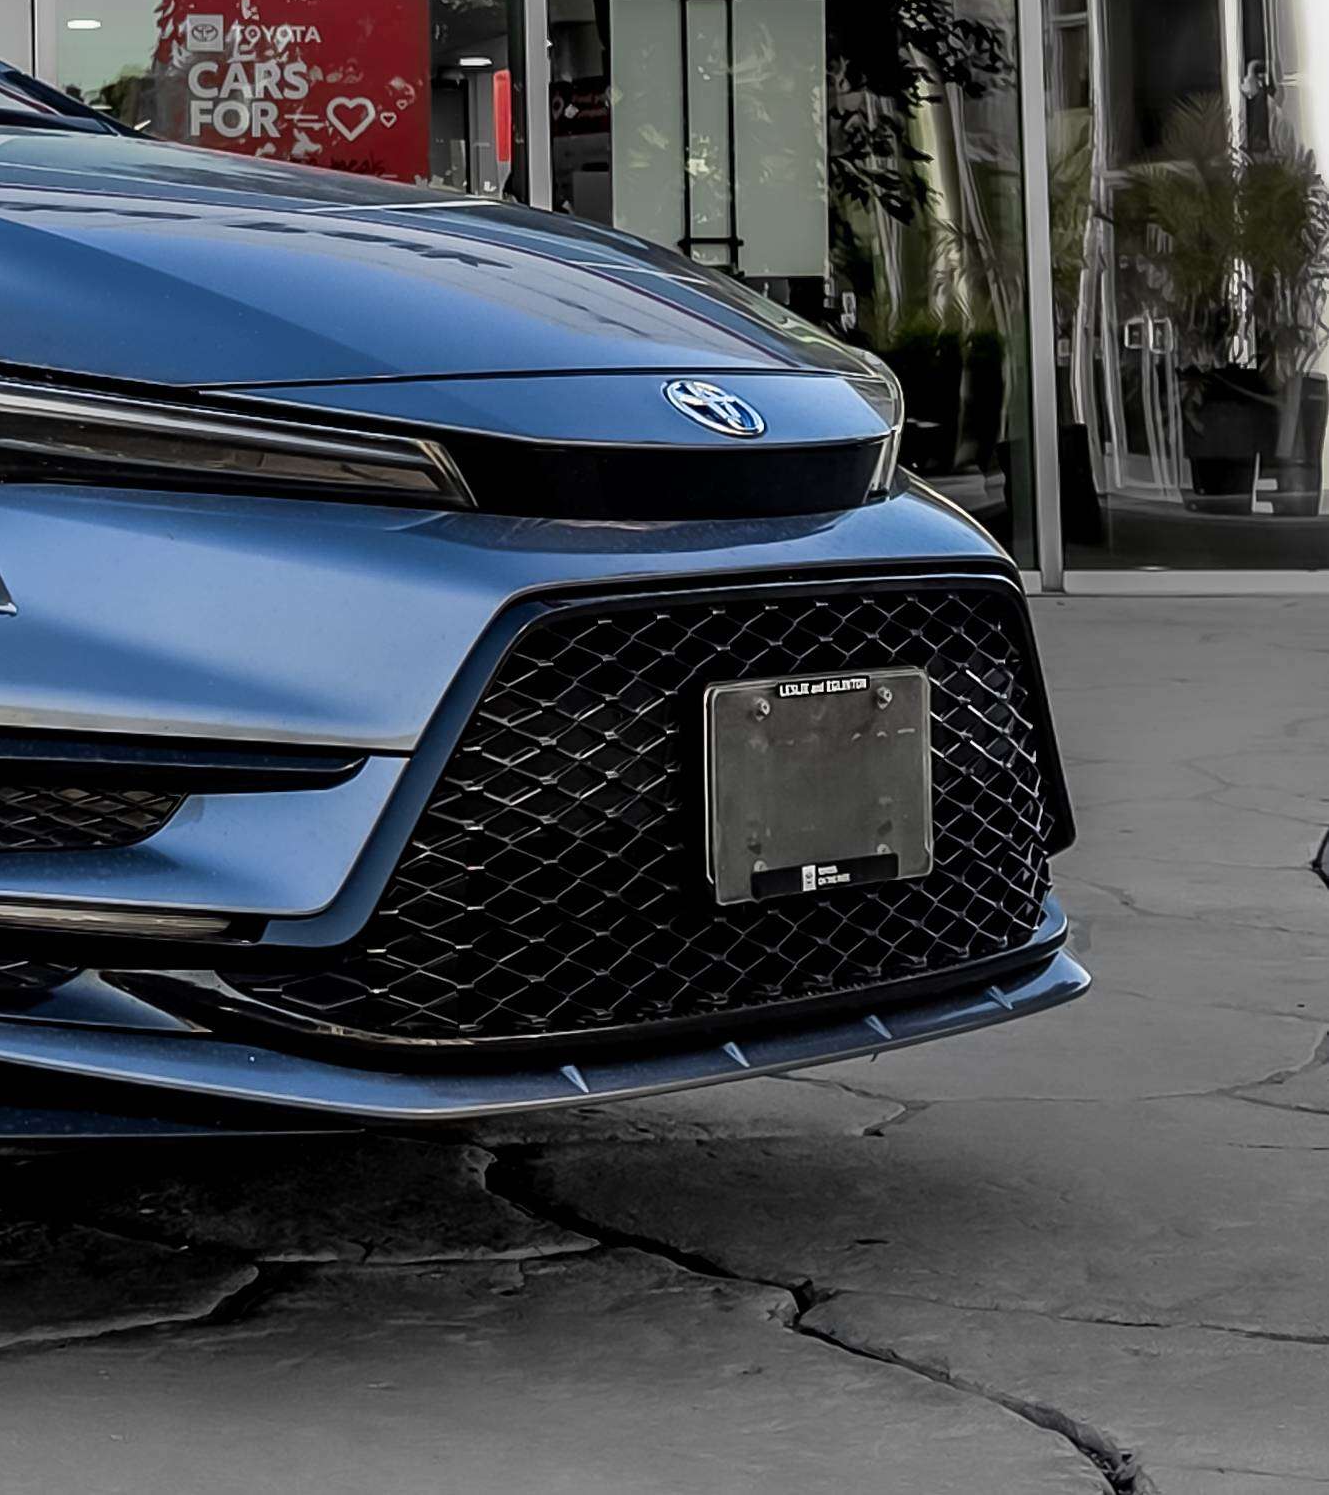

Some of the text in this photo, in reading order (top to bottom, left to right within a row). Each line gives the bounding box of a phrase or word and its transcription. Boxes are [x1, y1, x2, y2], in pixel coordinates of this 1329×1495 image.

[231, 23, 321, 43] TOYOTA
[188, 61, 310, 100] CARS
[190, 100, 281, 138] FOR
